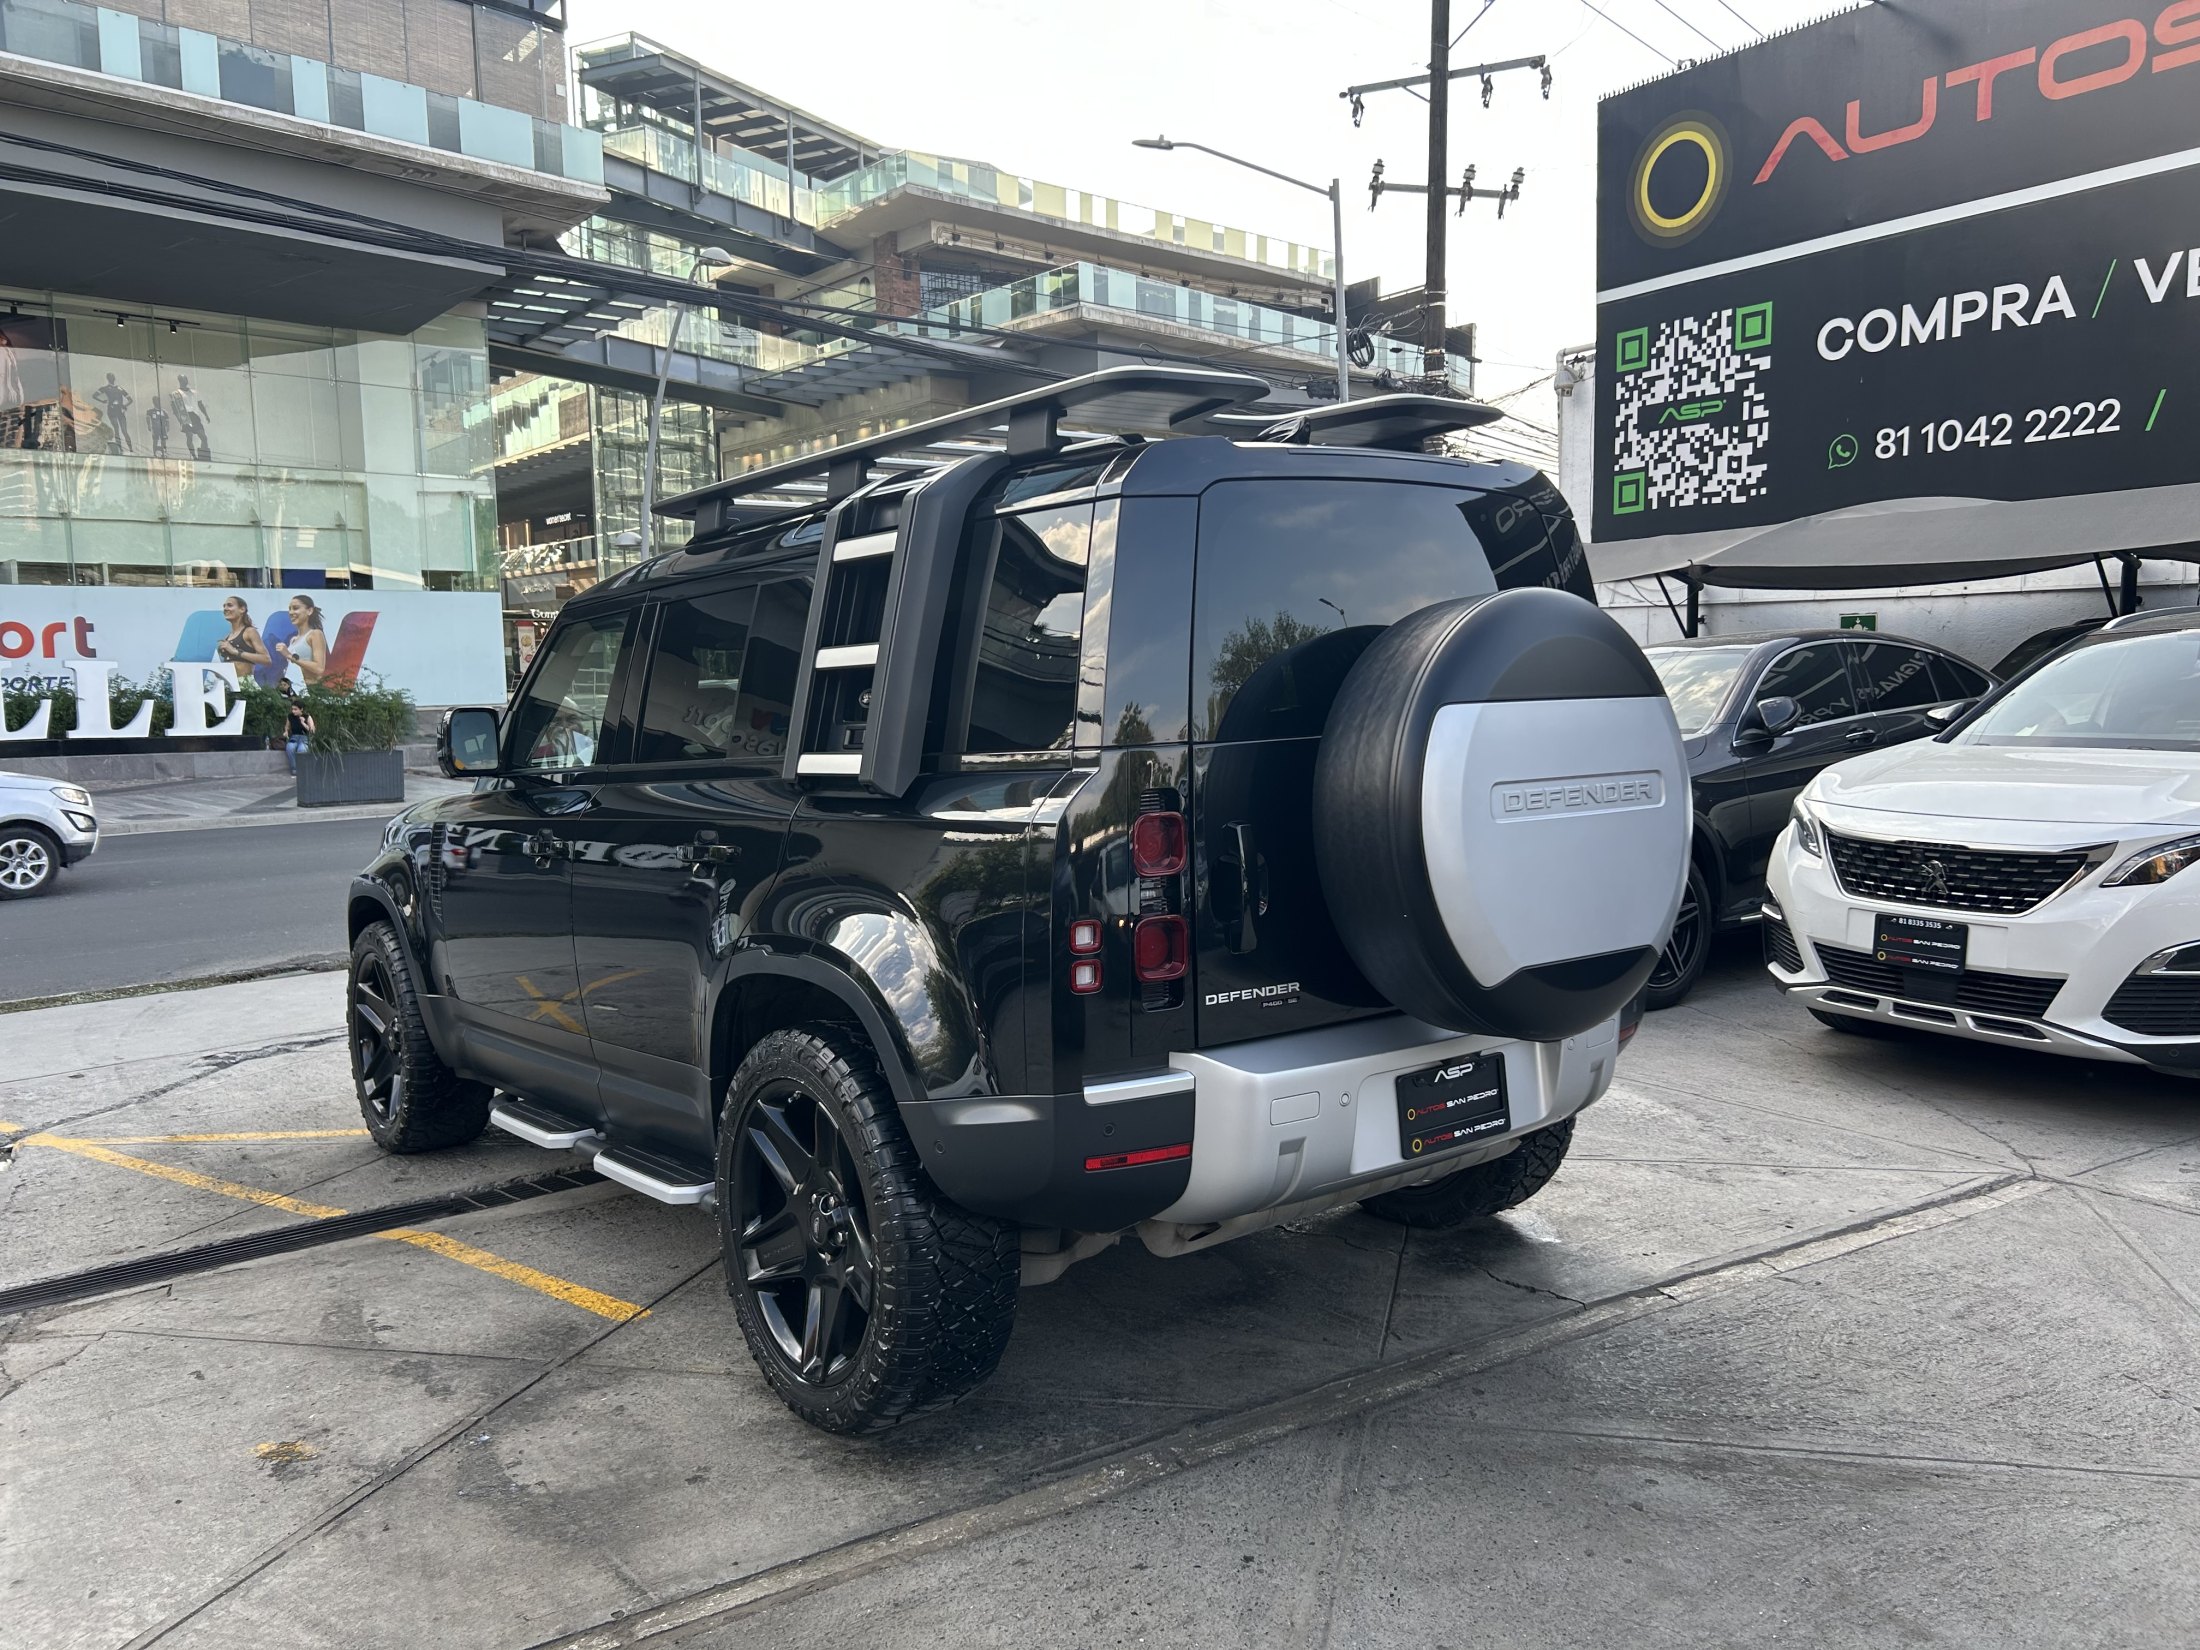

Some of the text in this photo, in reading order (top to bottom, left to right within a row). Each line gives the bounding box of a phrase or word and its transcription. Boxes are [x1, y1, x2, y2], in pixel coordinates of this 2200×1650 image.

[1816, 274, 2077, 361] COMPRA
[1874, 426, 1910, 459] 81
[1920, 413, 2013, 454] 1042
[2024, 398, 2121, 443] 2222
[0, 616, 97, 659] ort
[1503, 780, 1653, 813] DEFENDER
[1205, 981, 1300, 1006] DEFENDER
[1434, 1062, 1473, 1083] ASP
[1416, 1088, 1498, 1115] AUTOS SAN PEDRO
[1423, 1118, 1505, 1146] AUTOS SAN PEDRO
